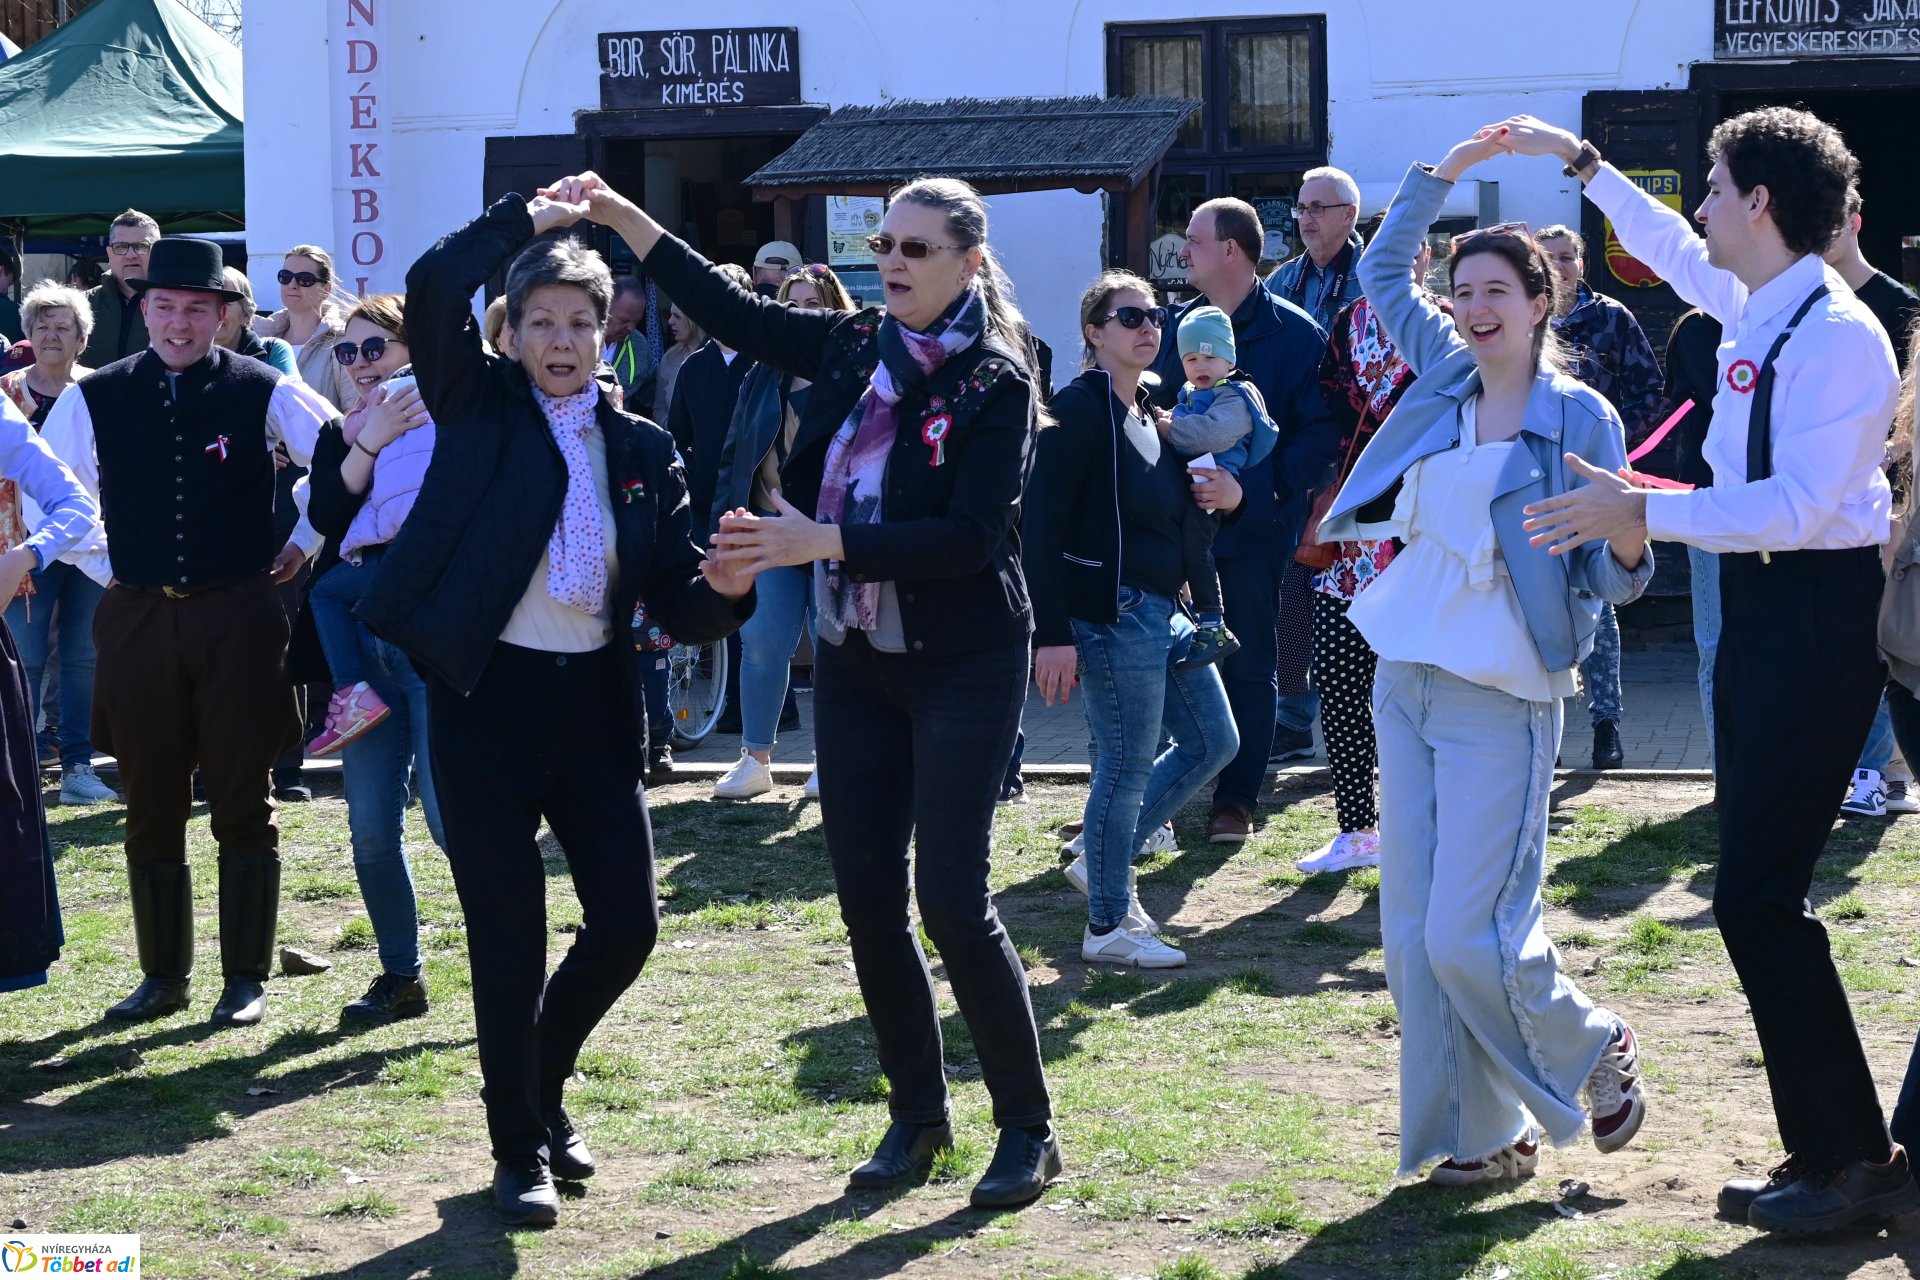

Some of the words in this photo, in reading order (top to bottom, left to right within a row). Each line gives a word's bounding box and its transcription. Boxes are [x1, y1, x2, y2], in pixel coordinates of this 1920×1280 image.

[1863, 0, 1920, 22] JAKA
[1725, 22, 1920, 53] VEGYESKERESKEDÉS
[608, 37, 650, 79] BOR,
[660, 32, 702, 77] SÖR,
[711, 29, 790, 74] PÁLINKA
[662, 77, 744, 104] KIMÉRÉS
[1332, 274, 1343, 297] Canon
